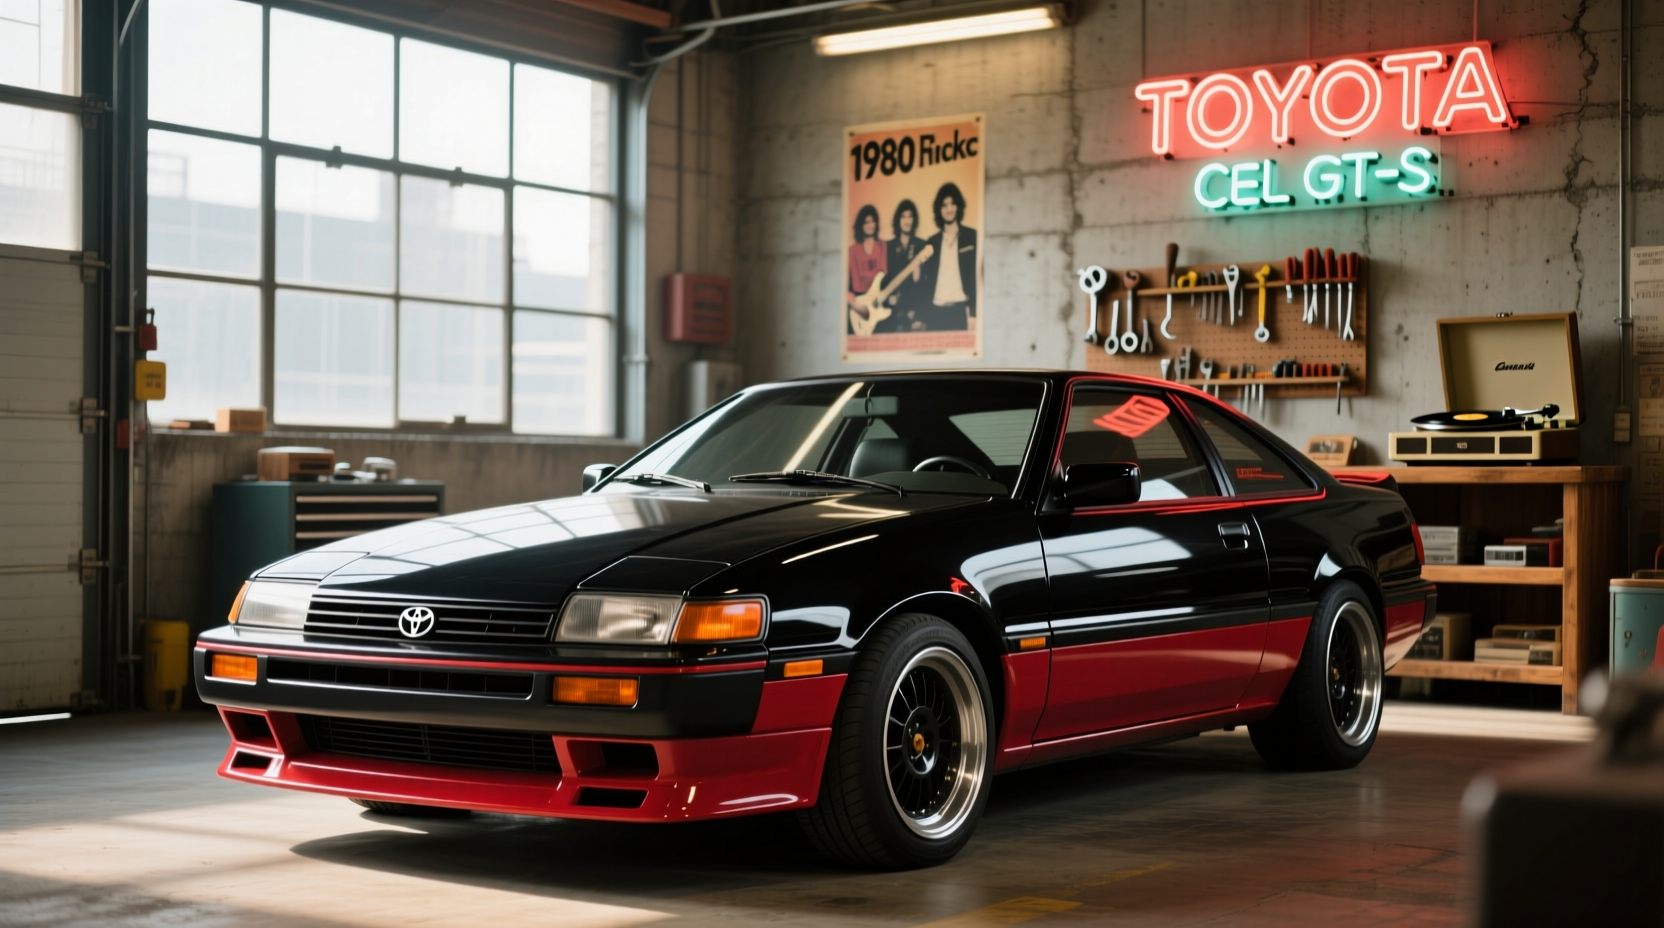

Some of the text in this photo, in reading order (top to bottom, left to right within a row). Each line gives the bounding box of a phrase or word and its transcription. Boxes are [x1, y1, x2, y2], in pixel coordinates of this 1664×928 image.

[1135, 47, 1507, 155] TOYOTA
[850, 136, 915, 182] 1980
[1194, 146, 1434, 208] CEL GT-S
